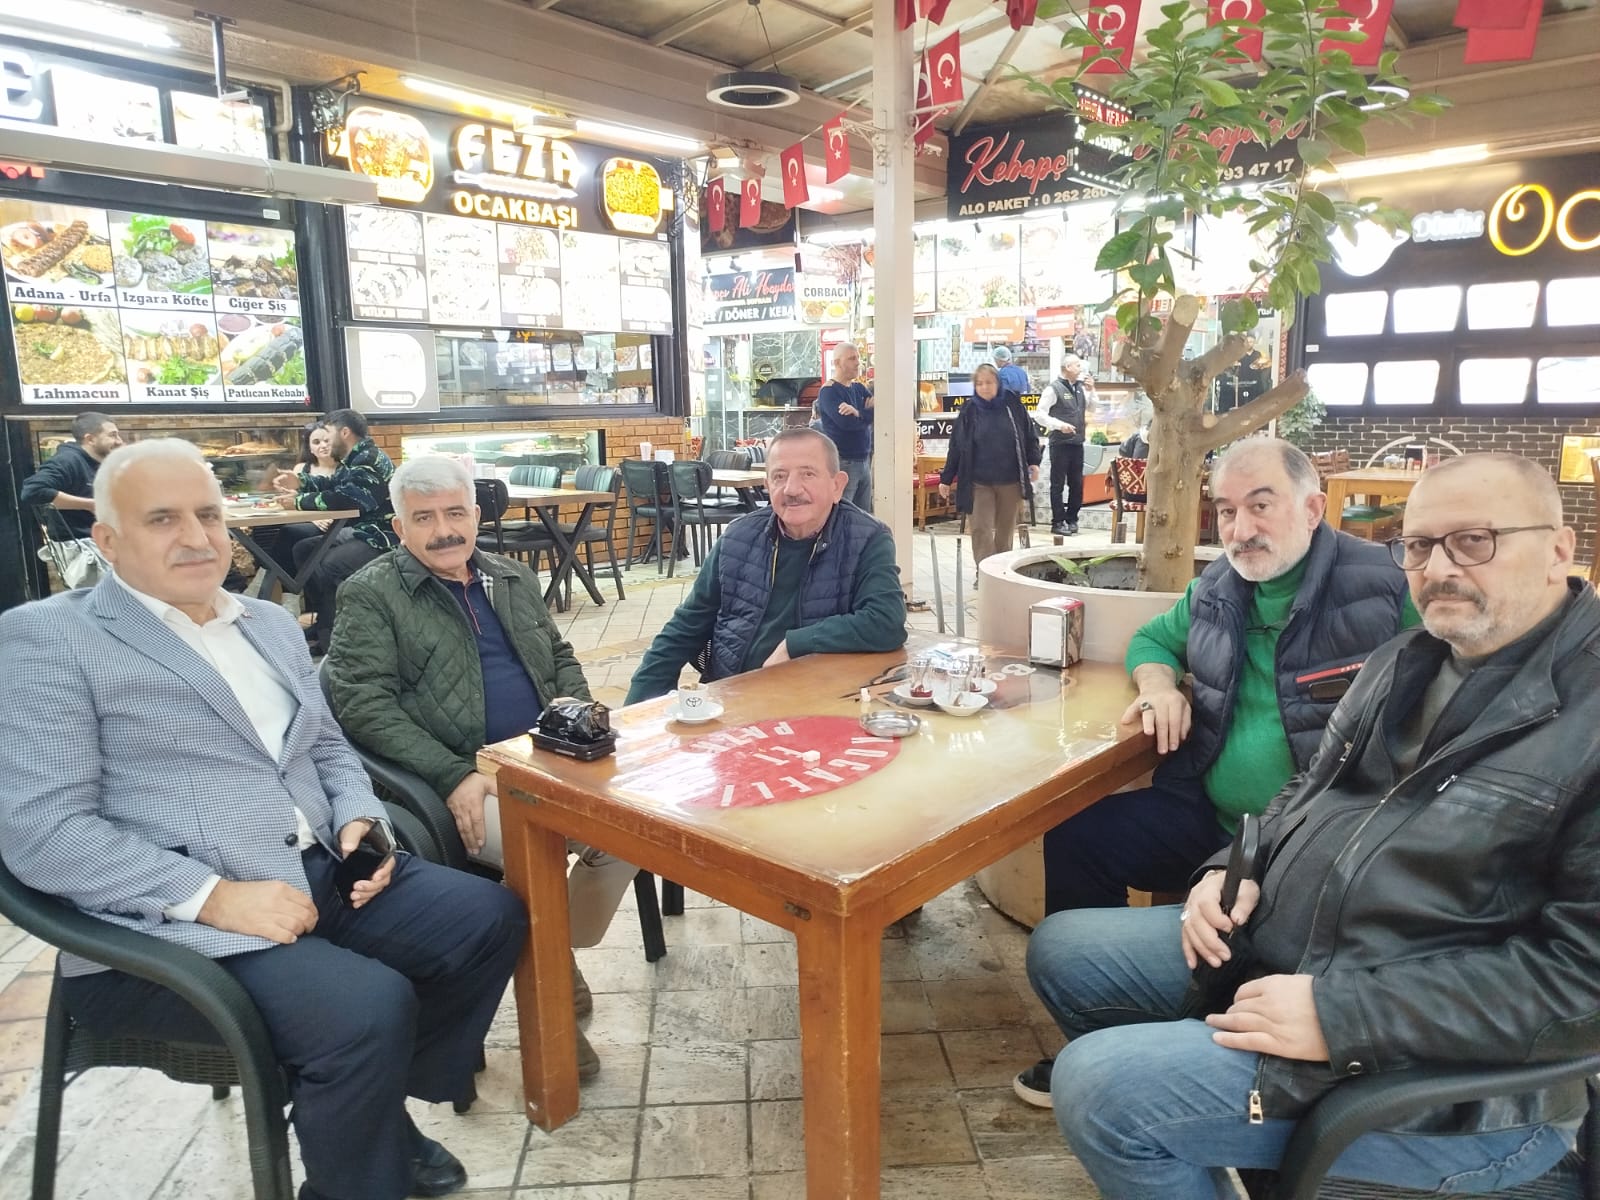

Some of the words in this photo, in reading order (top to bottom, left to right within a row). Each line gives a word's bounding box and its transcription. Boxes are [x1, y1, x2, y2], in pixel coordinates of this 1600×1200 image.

[457, 124, 580, 188] FEZA
[960, 131, 1069, 195] Kebapç
[959, 203, 985, 216] ALO
[987, 196, 1032, 212] PAKET
[1041, 194, 1050, 205] 0
[1053, 190, 1079, 203] 262
[1249, 162, 1270, 177] 47
[1273, 158, 1295, 173] 17
[454, 191, 578, 230] OCAKBAŞI
[14, 286, 65, 301] Adana
[79, 290, 112, 303] Urfa
[732, 275, 752, 299] Ali
[172, 294, 209, 307] Köfte
[229, 297, 264, 311] Ciğer
[268, 300, 287, 313] Şiş
[725, 307, 761, 321] DÖNER
[33, 388, 120, 400] Lahmacun
[146, 387, 187, 397] Kanat
[191, 387, 210, 399] Şiş
[228, 388, 270, 398] Patlıcan
[937, 420, 952, 436] Ye
